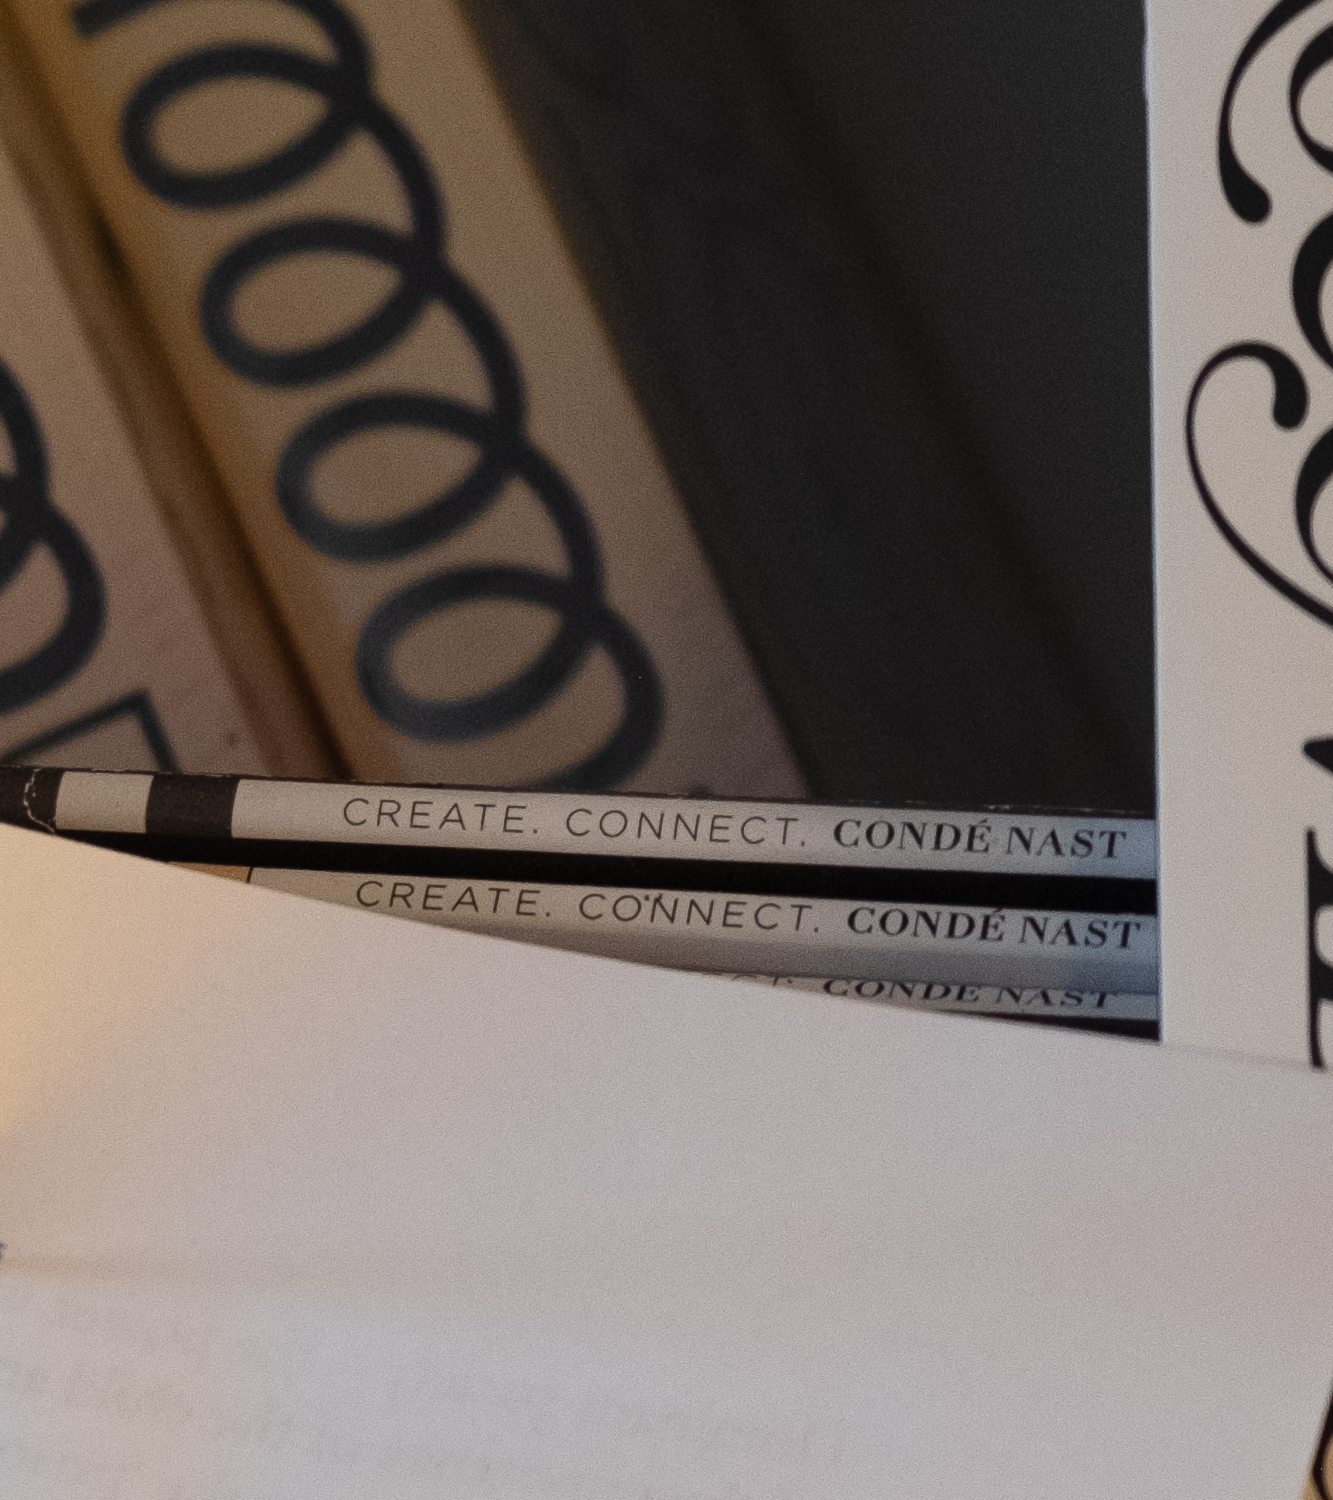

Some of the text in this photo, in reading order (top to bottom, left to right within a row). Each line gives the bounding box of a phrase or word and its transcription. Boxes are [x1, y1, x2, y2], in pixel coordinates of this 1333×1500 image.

[341, 796, 1128, 860] CREATE. CONNECT. CONDÉ NAST
[354, 879, 1142, 950] CREATE. CONNECT. CONDÉ NAST
